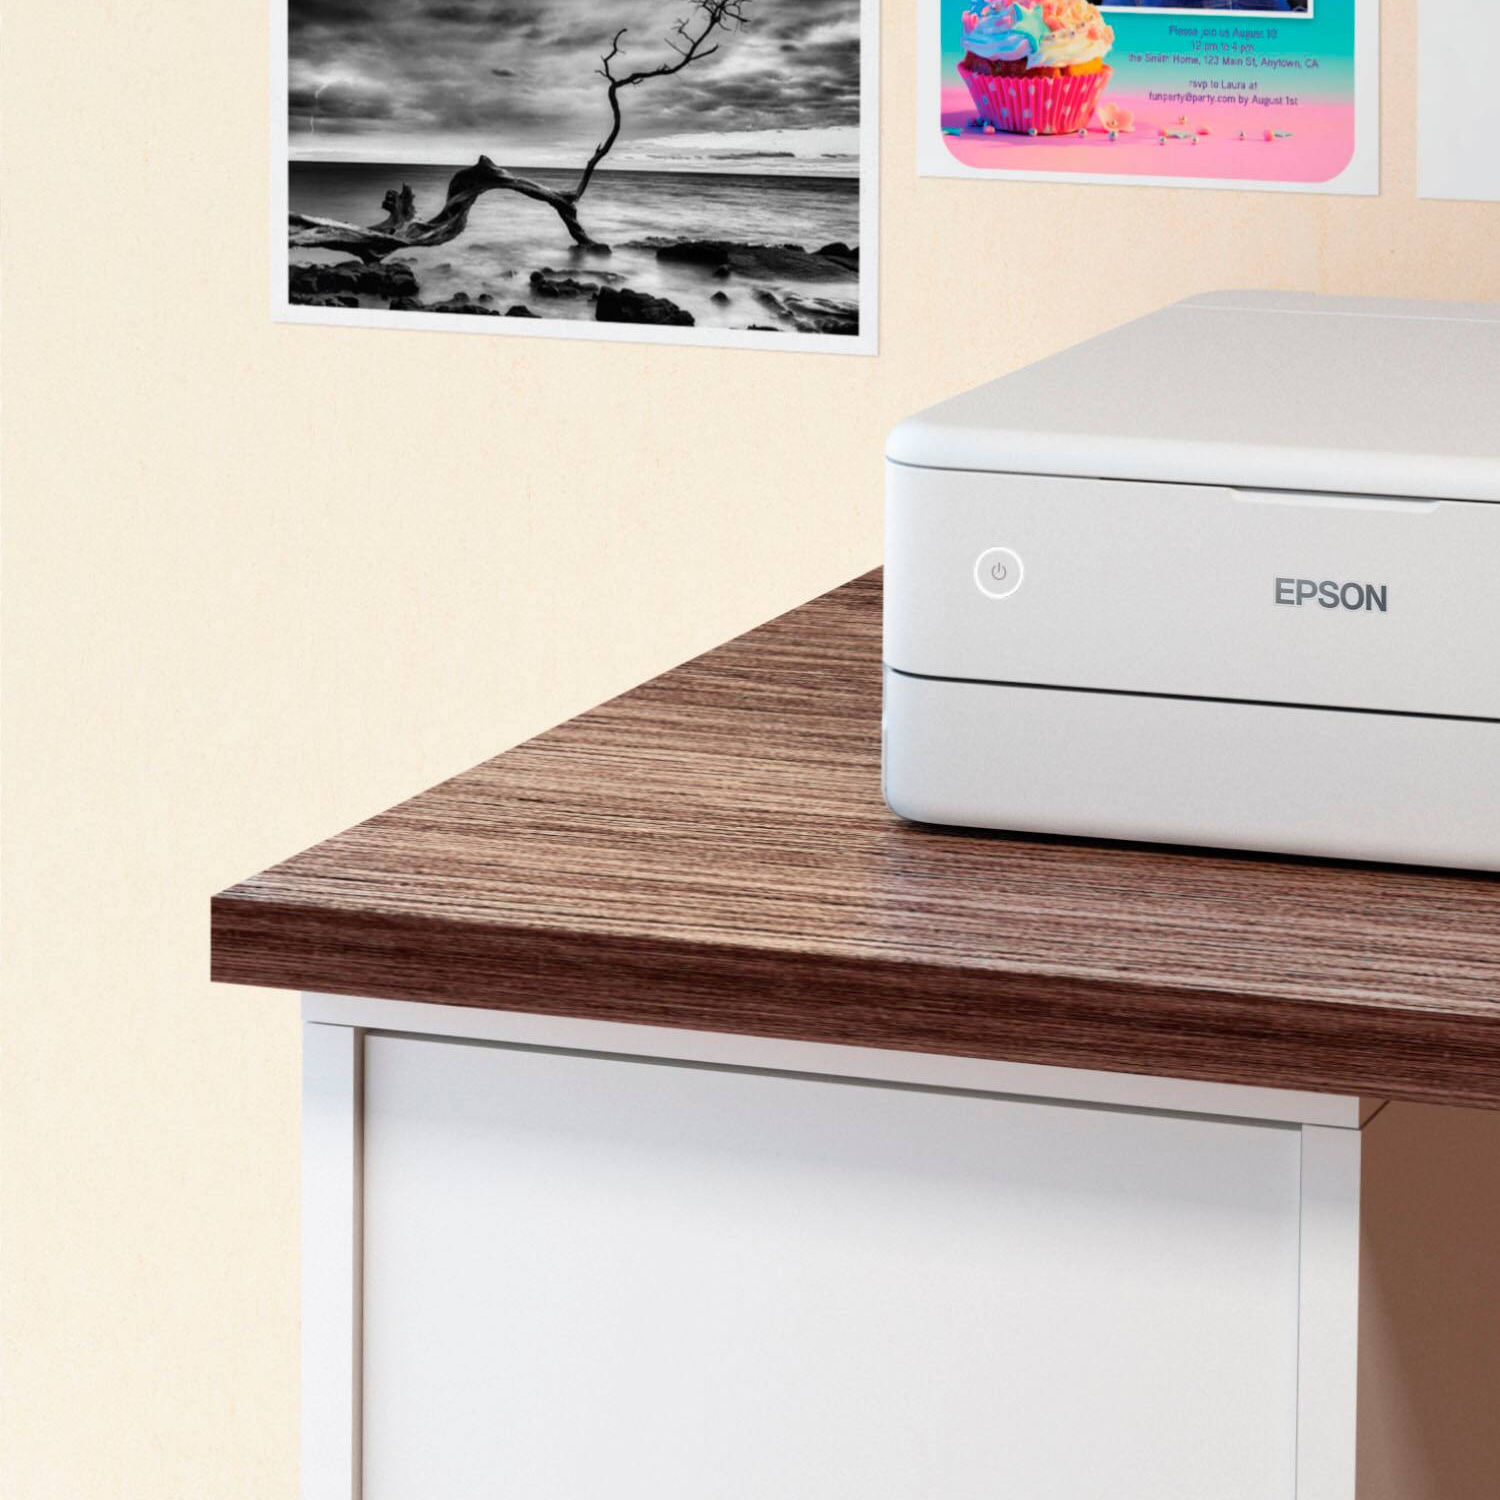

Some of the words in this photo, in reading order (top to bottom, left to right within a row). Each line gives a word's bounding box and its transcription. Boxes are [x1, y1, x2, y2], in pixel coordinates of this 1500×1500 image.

[1204, 43, 1219, 54] pm
[1305, 59, 1319, 69] CA
[1189, 79, 1208, 90] rsvp
[1210, 79, 1219, 89] to
[1221, 80, 1246, 91] Laura
[1249, 81, 1258, 90] at
[1238, 95, 1249, 107] by
[1251, 95, 1283, 108] August
[1274, 577, 1387, 613] EPSON
